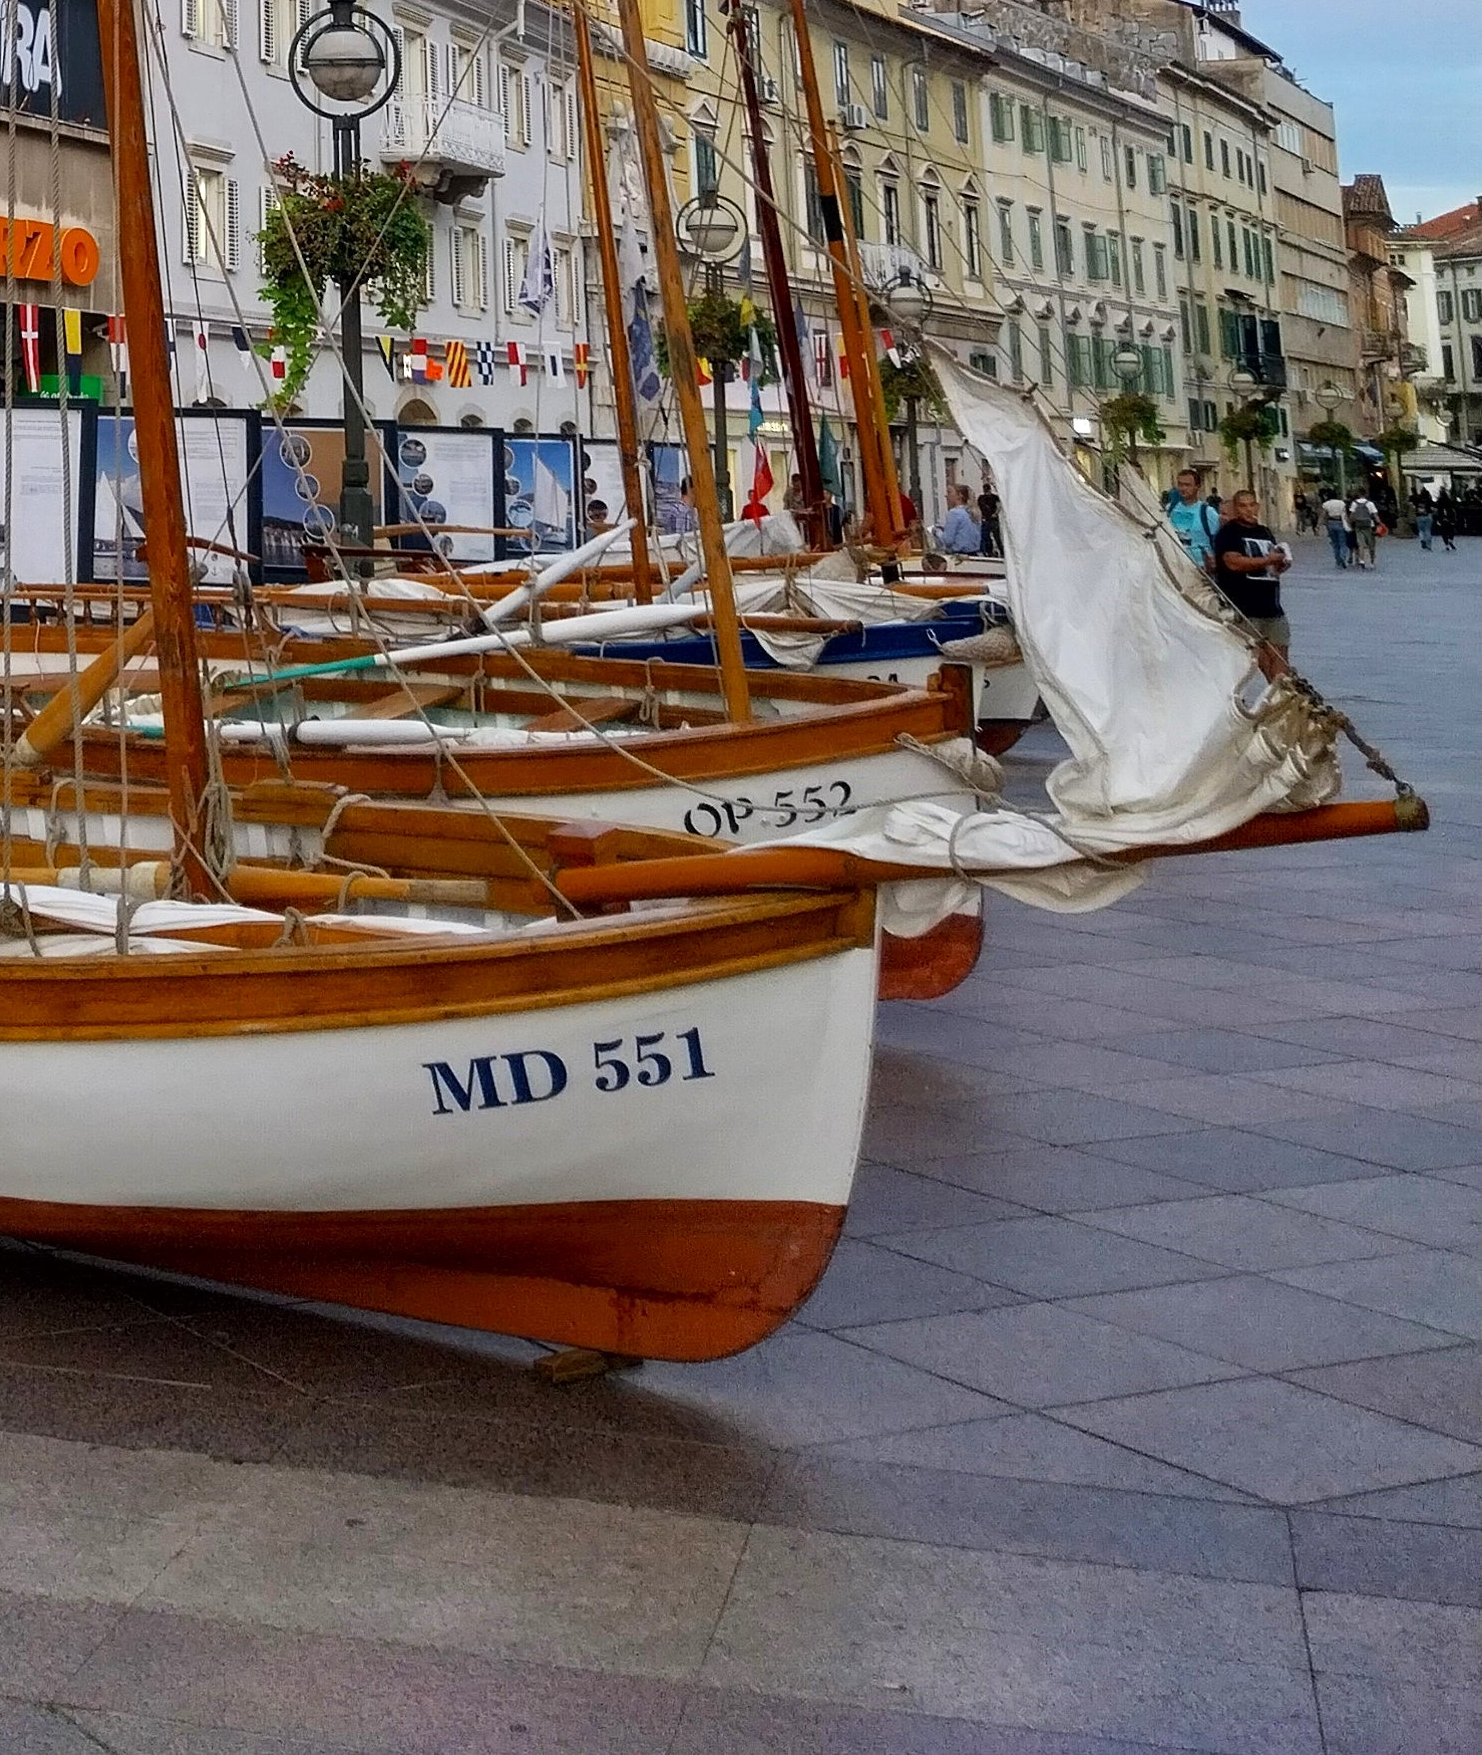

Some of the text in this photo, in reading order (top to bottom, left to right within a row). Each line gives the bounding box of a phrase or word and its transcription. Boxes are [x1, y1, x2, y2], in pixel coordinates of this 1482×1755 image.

[774, 780, 859, 828] 552
[422, 1026, 716, 1116] MD 551
